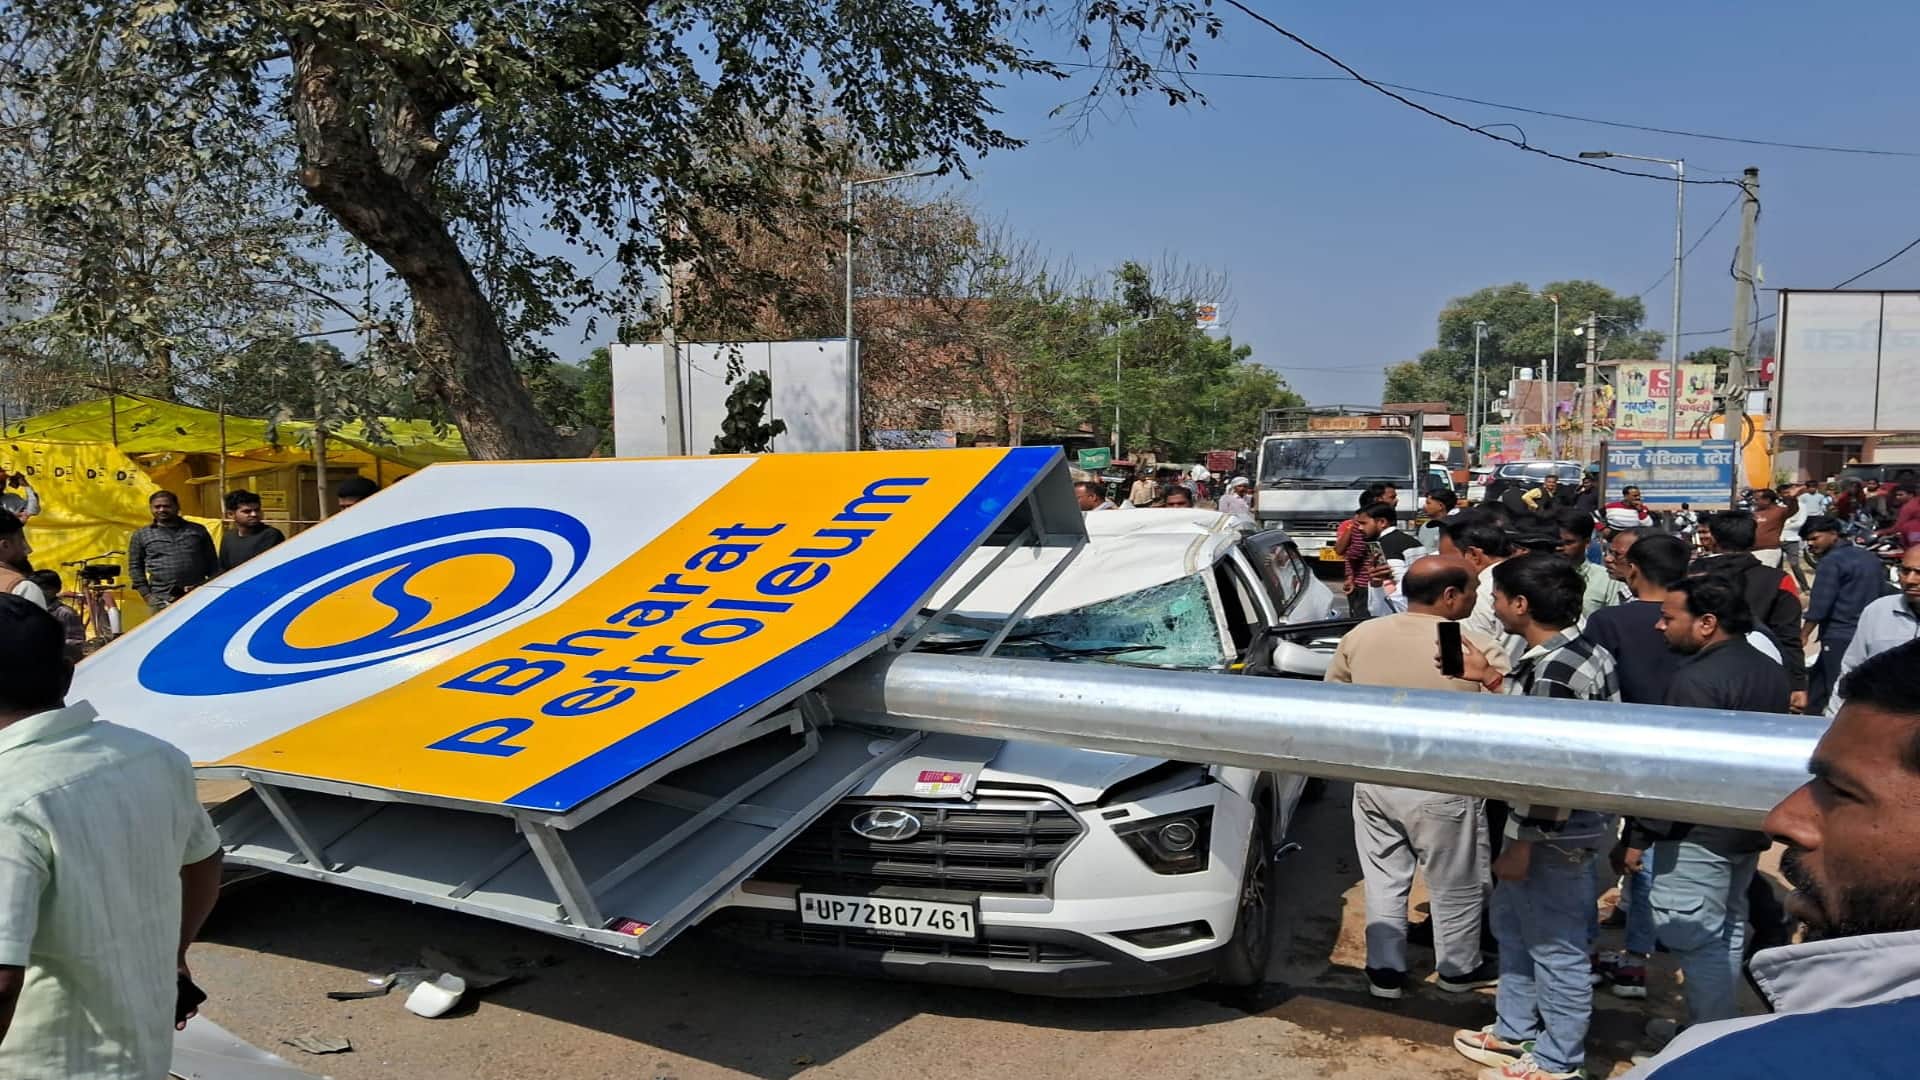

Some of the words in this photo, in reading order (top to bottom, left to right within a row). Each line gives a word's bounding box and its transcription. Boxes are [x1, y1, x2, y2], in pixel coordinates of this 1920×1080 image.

[1608, 450, 1641, 469] गोलू
[1704, 449, 1731, 465] स्टोर
[425, 476, 931, 757] Petroleum
[439, 522, 787, 696] Bharat
[816, 899, 970, 932] UP72BQ7461
